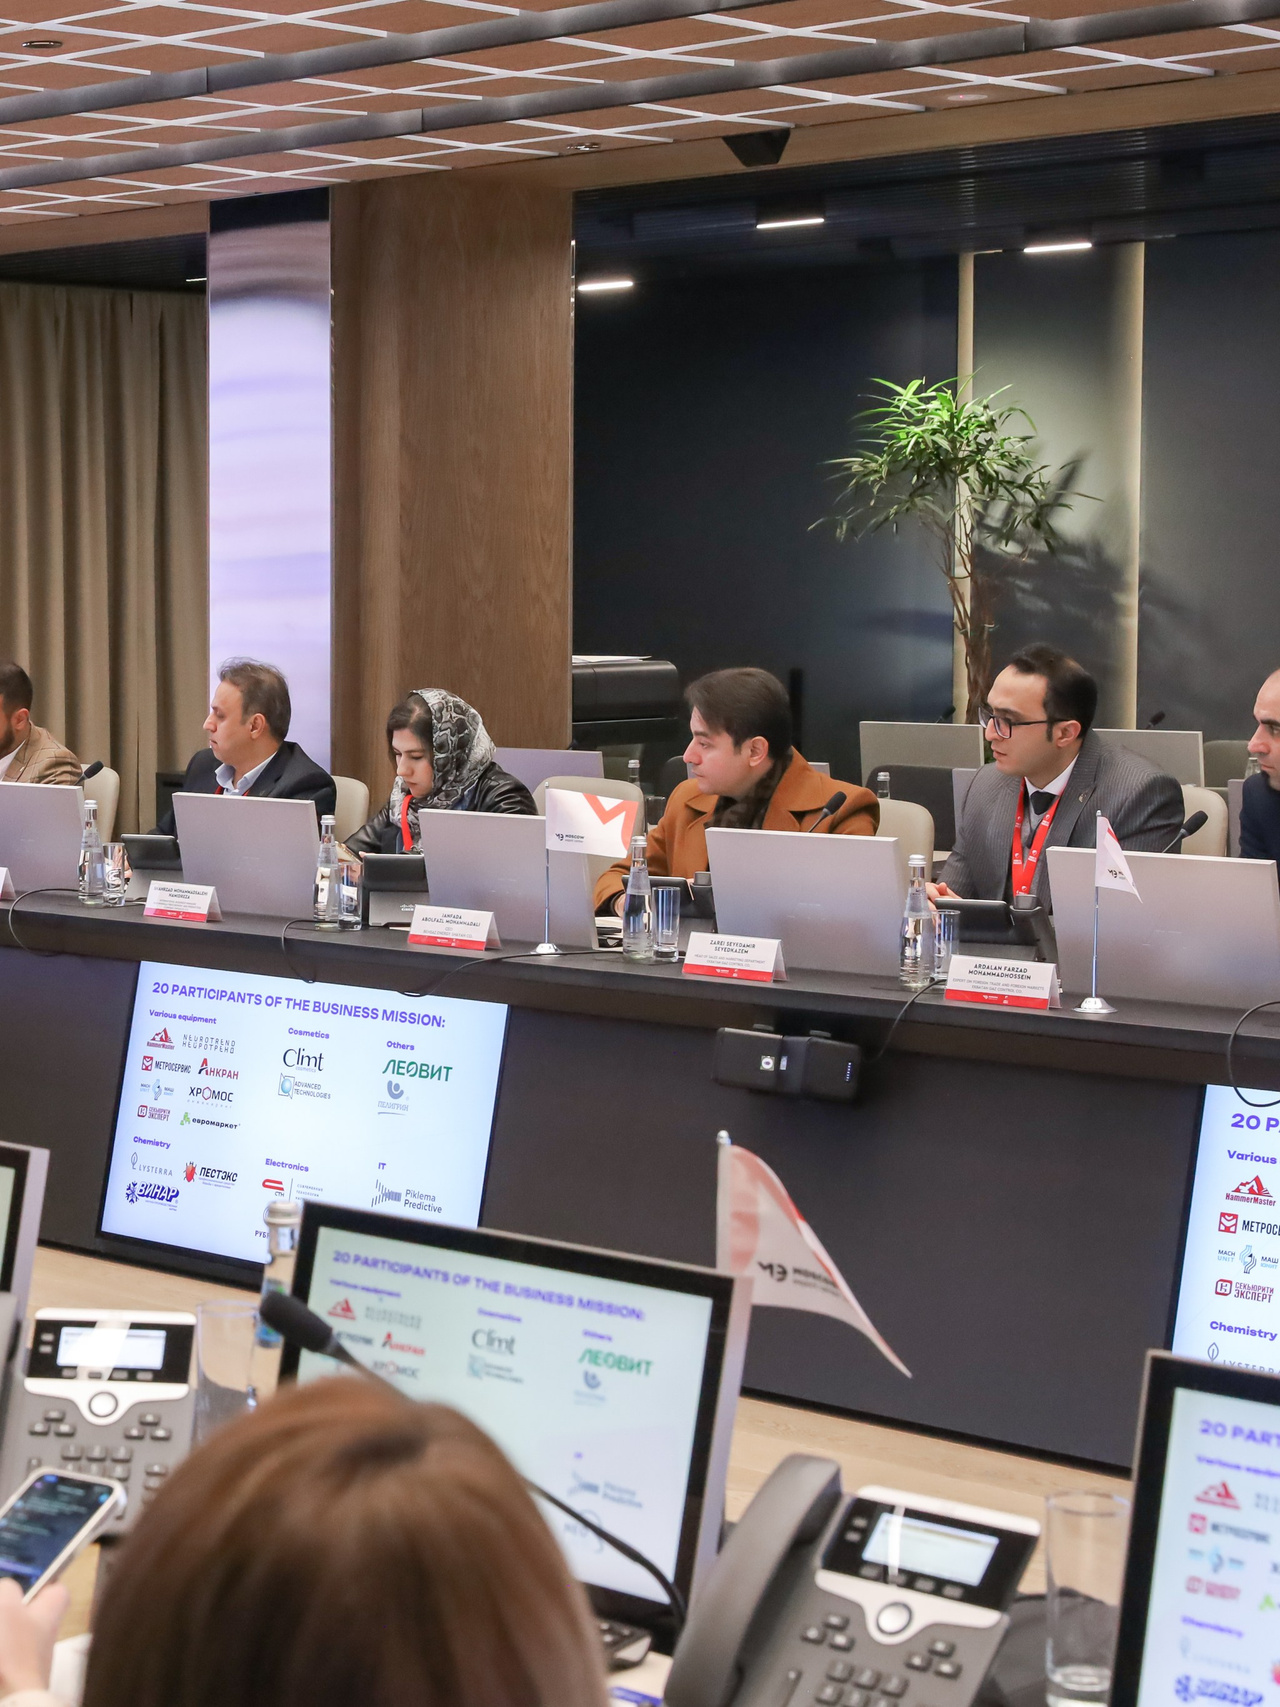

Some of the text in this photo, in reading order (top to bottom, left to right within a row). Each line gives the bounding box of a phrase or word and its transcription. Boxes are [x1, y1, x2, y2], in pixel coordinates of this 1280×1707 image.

[968, 970, 1031, 980] MOHAMMADHOSSEIN
[152, 982, 446, 1029] 20 PARTICIPANTS OF THE BUSINESS MISSION:
[149, 1009, 217, 1024] Various equipment
[288, 1027, 330, 1040] Cosmetics
[386, 1040, 415, 1051] Others
[155, 1060, 191, 1074] МЕТРОСЕРВИС
[382, 1059, 453, 1082] ЛЕОВИТ
[294, 1081, 321, 1090] ADVANCED
[189, 1086, 234, 1102] ХРОМОС
[294, 1089, 331, 1099] TECHNOLOGIES
[148, 1112, 169, 1122] ЭКСПЕРТ
[192, 1118, 238, 1129] евромаркет
[1231, 1113, 1261, 1131] 20
[133, 1136, 171, 1149] Chemistry
[1227, 1150, 1277, 1165] Various
[139, 1164, 173, 1177] LYSTERRA
[265, 1158, 309, 1172] Electronics
[378, 1162, 387, 1170] IT
[199, 1167, 238, 1182] ПЕСТЭКС
[137, 1181, 180, 1203] ВИНАР
[405, 1189, 436, 1202] Piklema
[404, 1199, 442, 1214] Predictive
[1225, 1193, 1276, 1207] HammerMaster
[1242, 1220, 1280, 1236] МЕТРОС
[353, 1254, 450, 1283] PARTICIPANTS
[453, 1272, 471, 1287] OF
[474, 1276, 501, 1292] THE
[504, 1281, 574, 1308] BUSINESS
[1235, 1282, 1274, 1295] СЕКЬЮРИТИ
[1234, 1289, 1272, 1303] ЭКСПЕРТ
[1210, 1321, 1278, 1342] Chemistry
[578, 1347, 654, 1377] ЛЕОВИТ
[1199, 1419, 1227, 1438] 20
